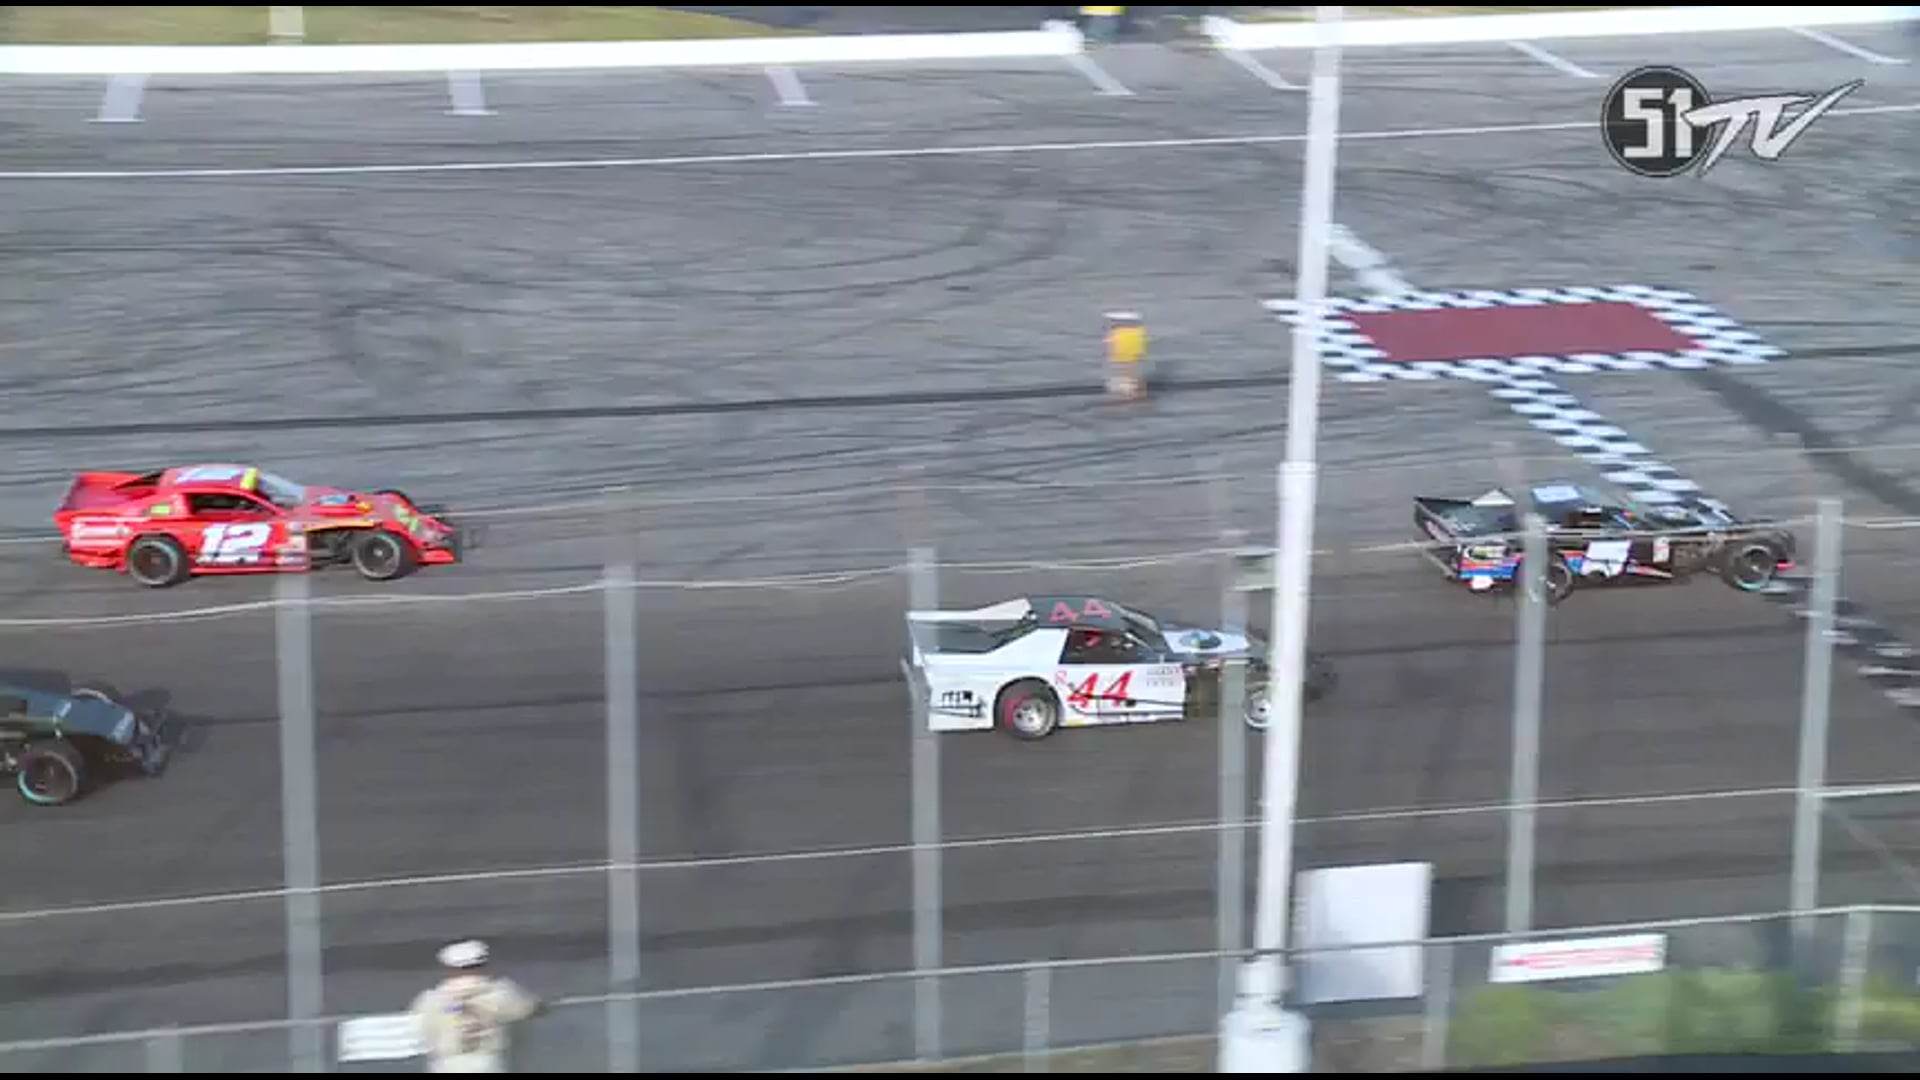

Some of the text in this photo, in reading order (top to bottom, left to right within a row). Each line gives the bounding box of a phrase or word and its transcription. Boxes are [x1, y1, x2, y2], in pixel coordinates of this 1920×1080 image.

[196, 521, 272, 564] 12
[1047, 598, 1112, 623] 44
[1066, 671, 1134, 709] 44
